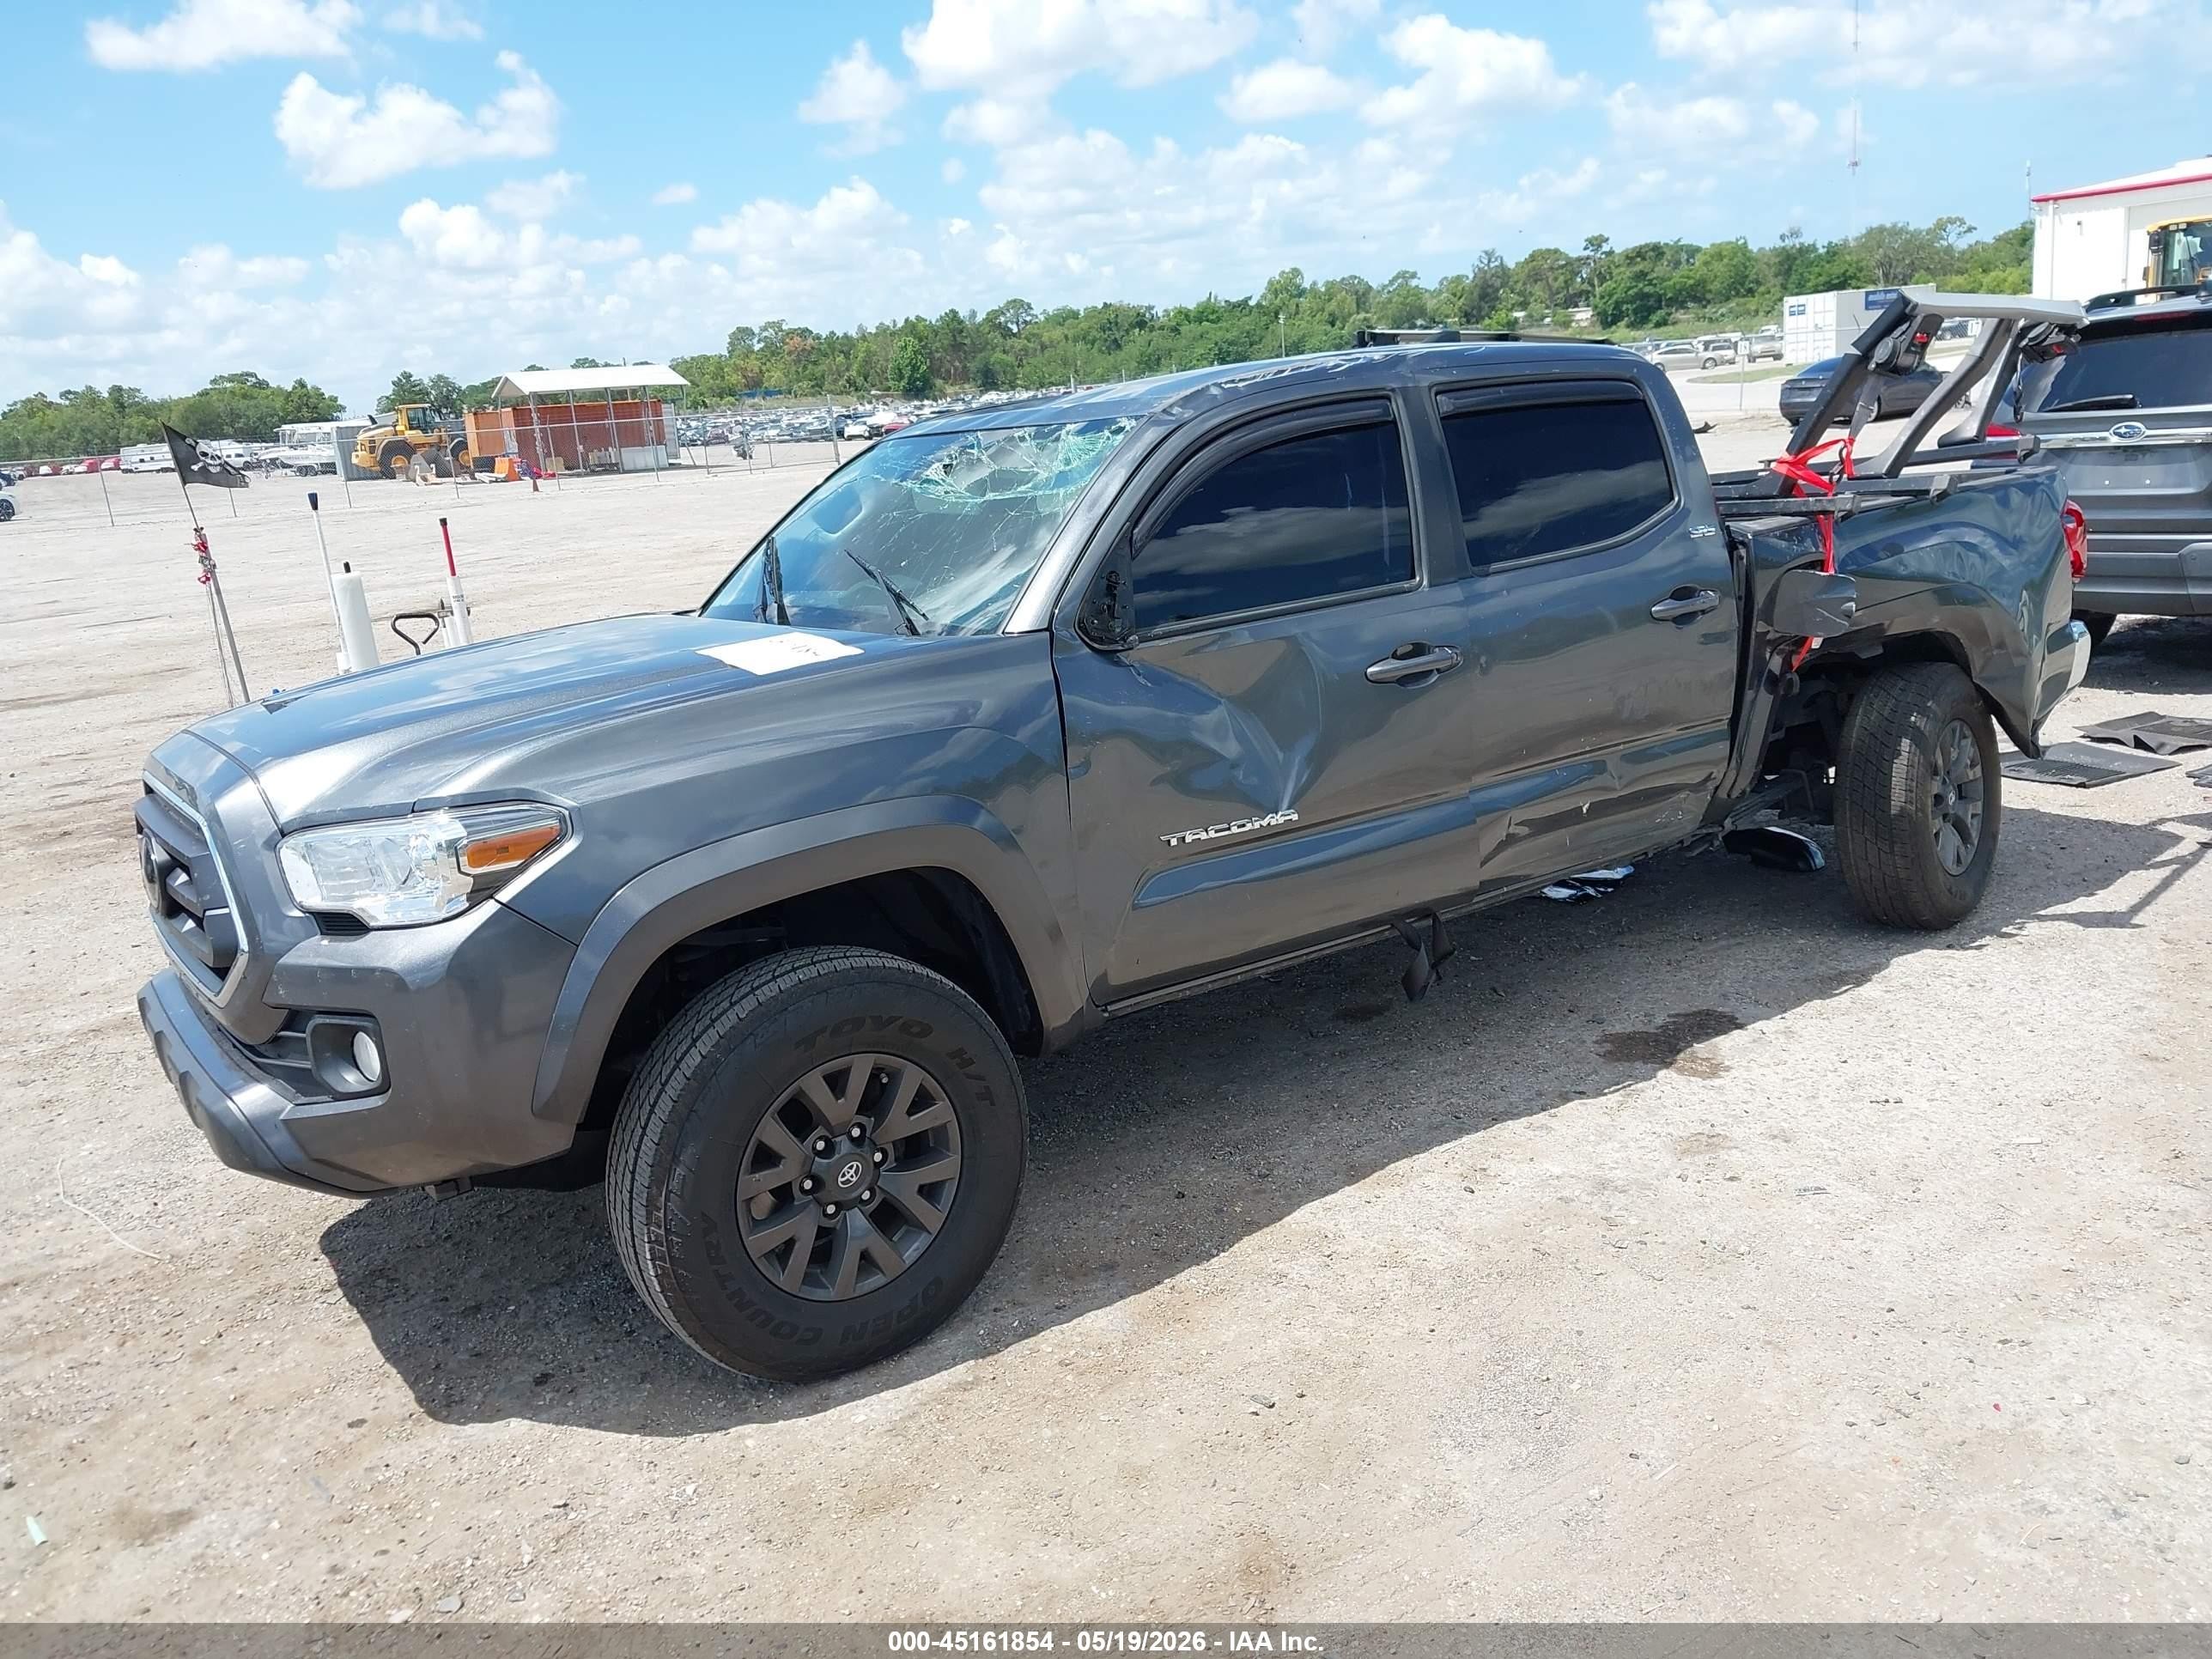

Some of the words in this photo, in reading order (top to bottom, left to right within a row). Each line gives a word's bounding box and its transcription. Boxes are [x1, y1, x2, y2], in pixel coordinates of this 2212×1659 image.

[1159, 808, 1299, 847] TACOMA
[793, 1014, 933, 1053] TOYO
[945, 1045, 997, 1107] H/T
[700, 1211, 824, 1346] COUNTRY
[839, 1275, 944, 1346] OPEN
